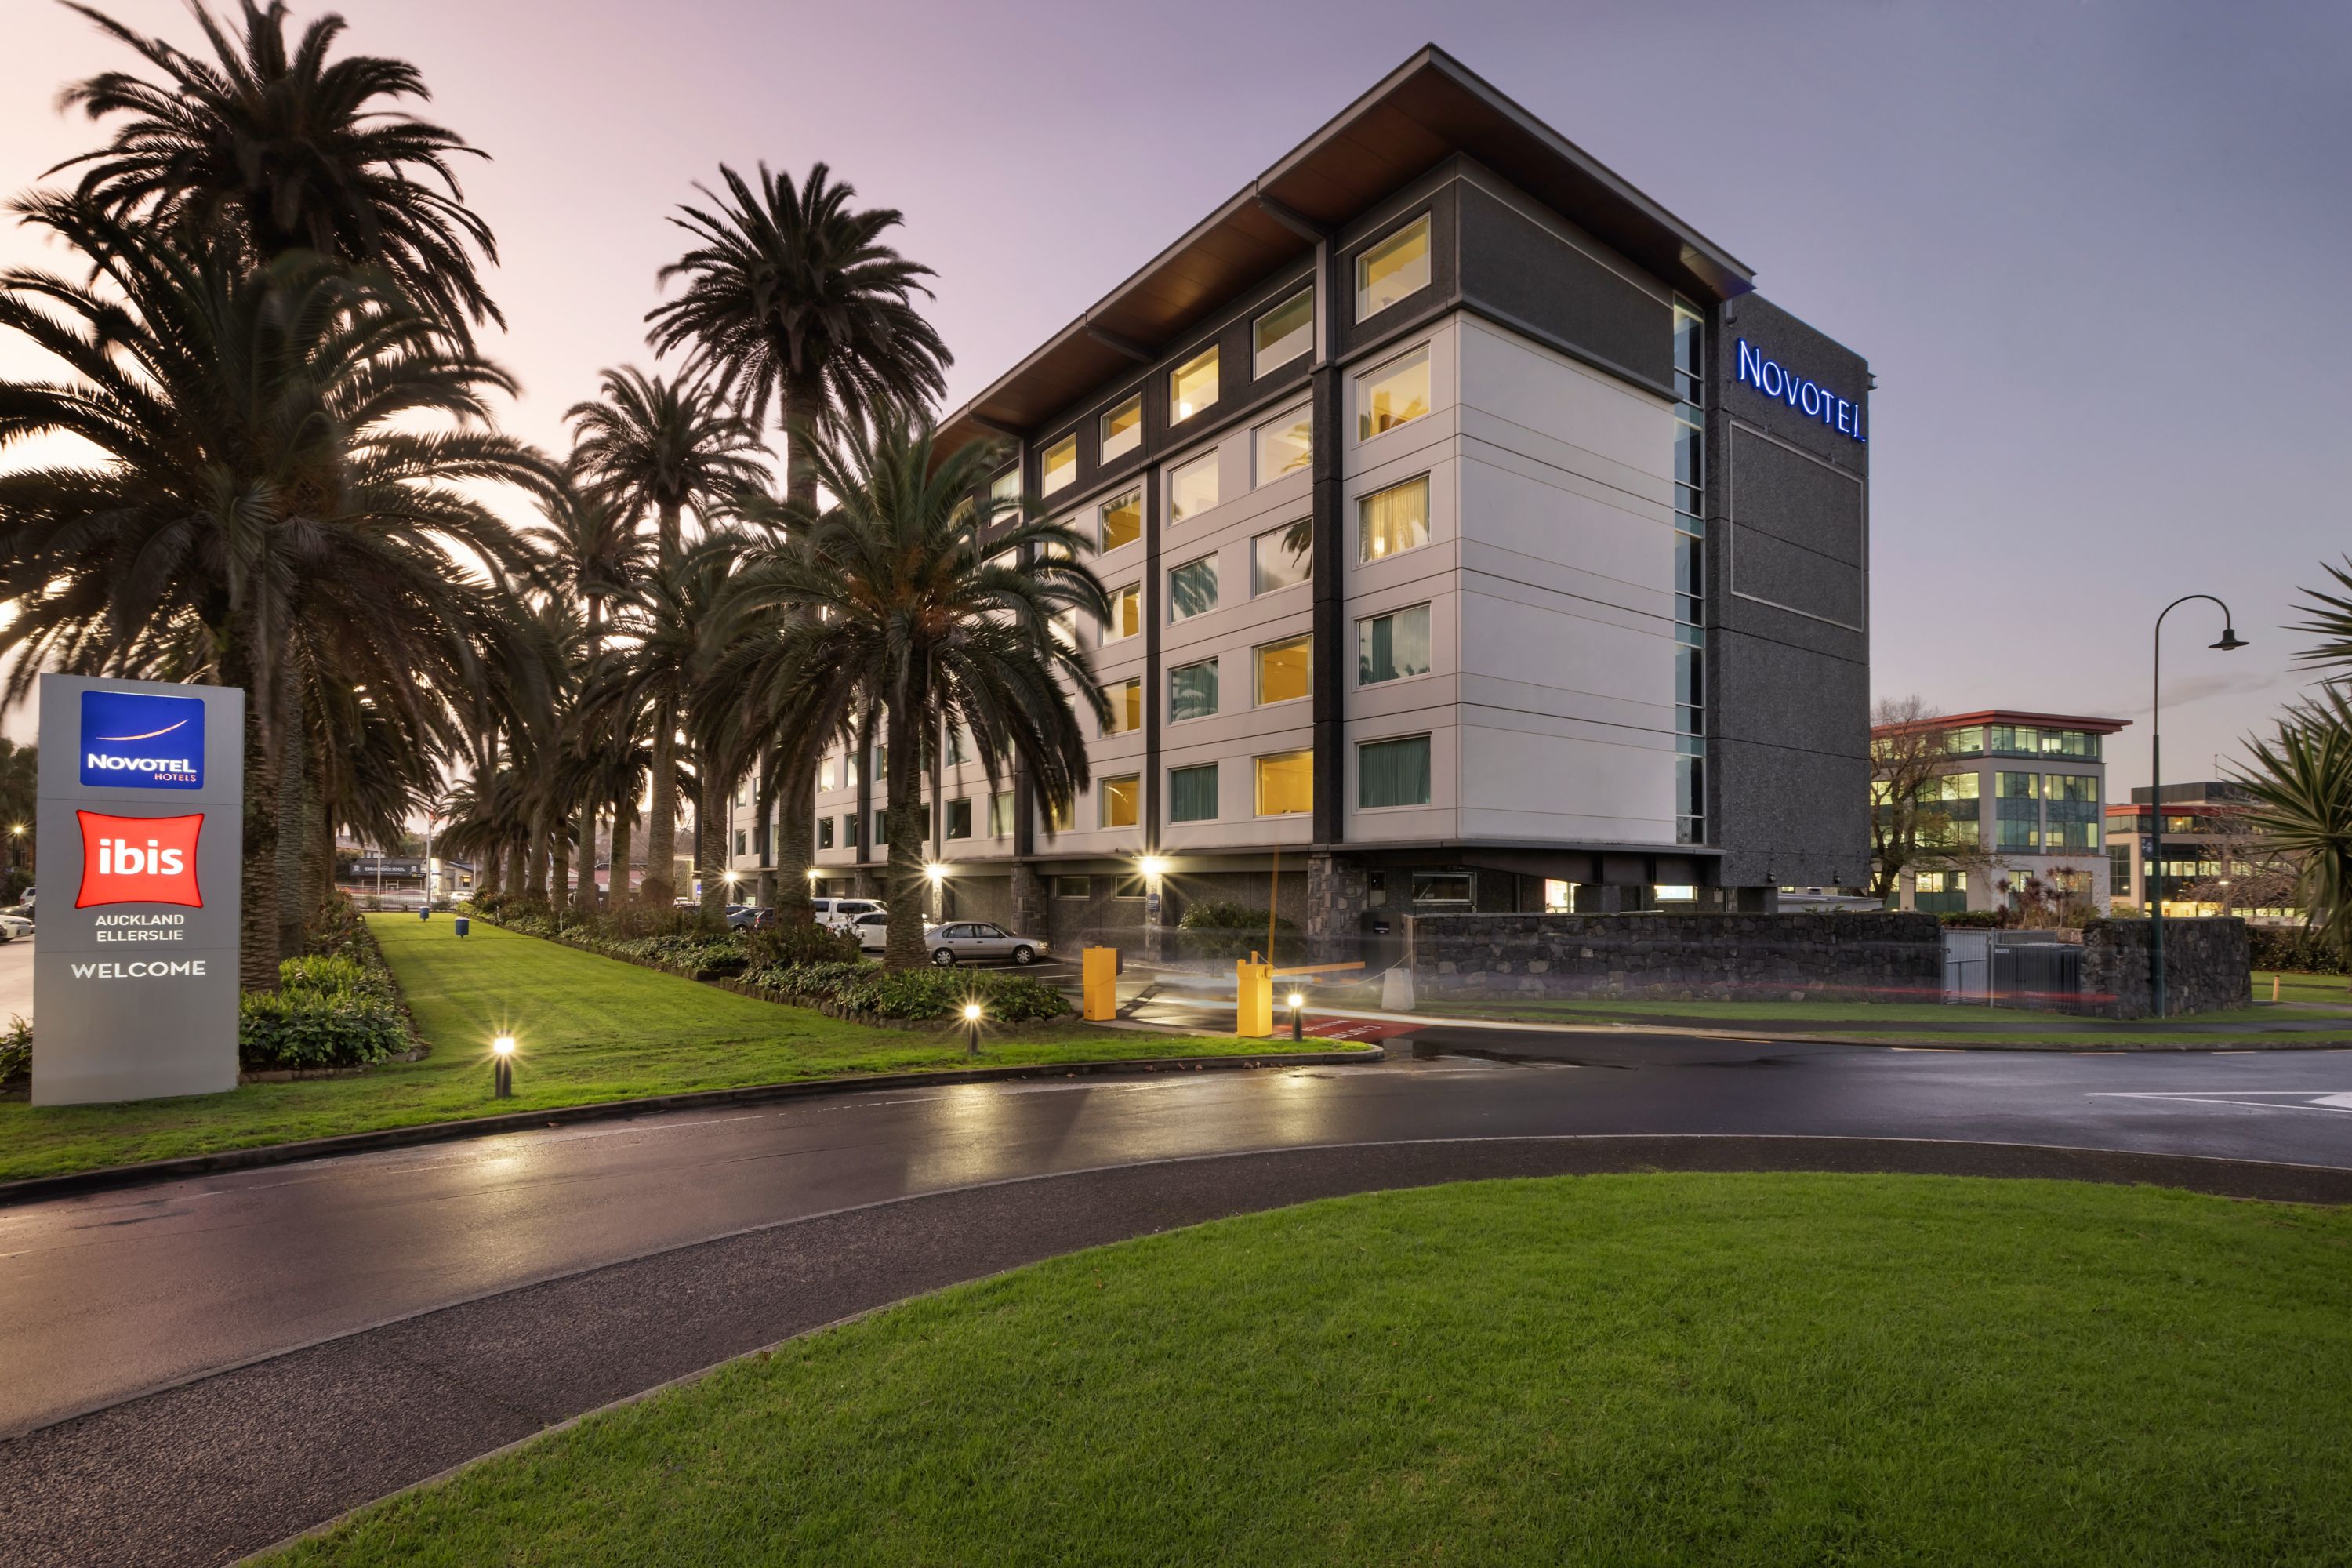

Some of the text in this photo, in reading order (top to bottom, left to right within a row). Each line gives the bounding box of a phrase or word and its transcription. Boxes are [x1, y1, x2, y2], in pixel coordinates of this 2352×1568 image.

[1737, 337, 1867, 443] NOVOTEL
[87, 753, 197, 773] NOVOTEL
[154, 773, 197, 782] HOTELS
[100, 838, 184, 875] ibis
[95, 914, 184, 926] AUCKLAND
[96, 930, 183, 942] ELLERSLIE
[71, 960, 206, 979] WELCOME
